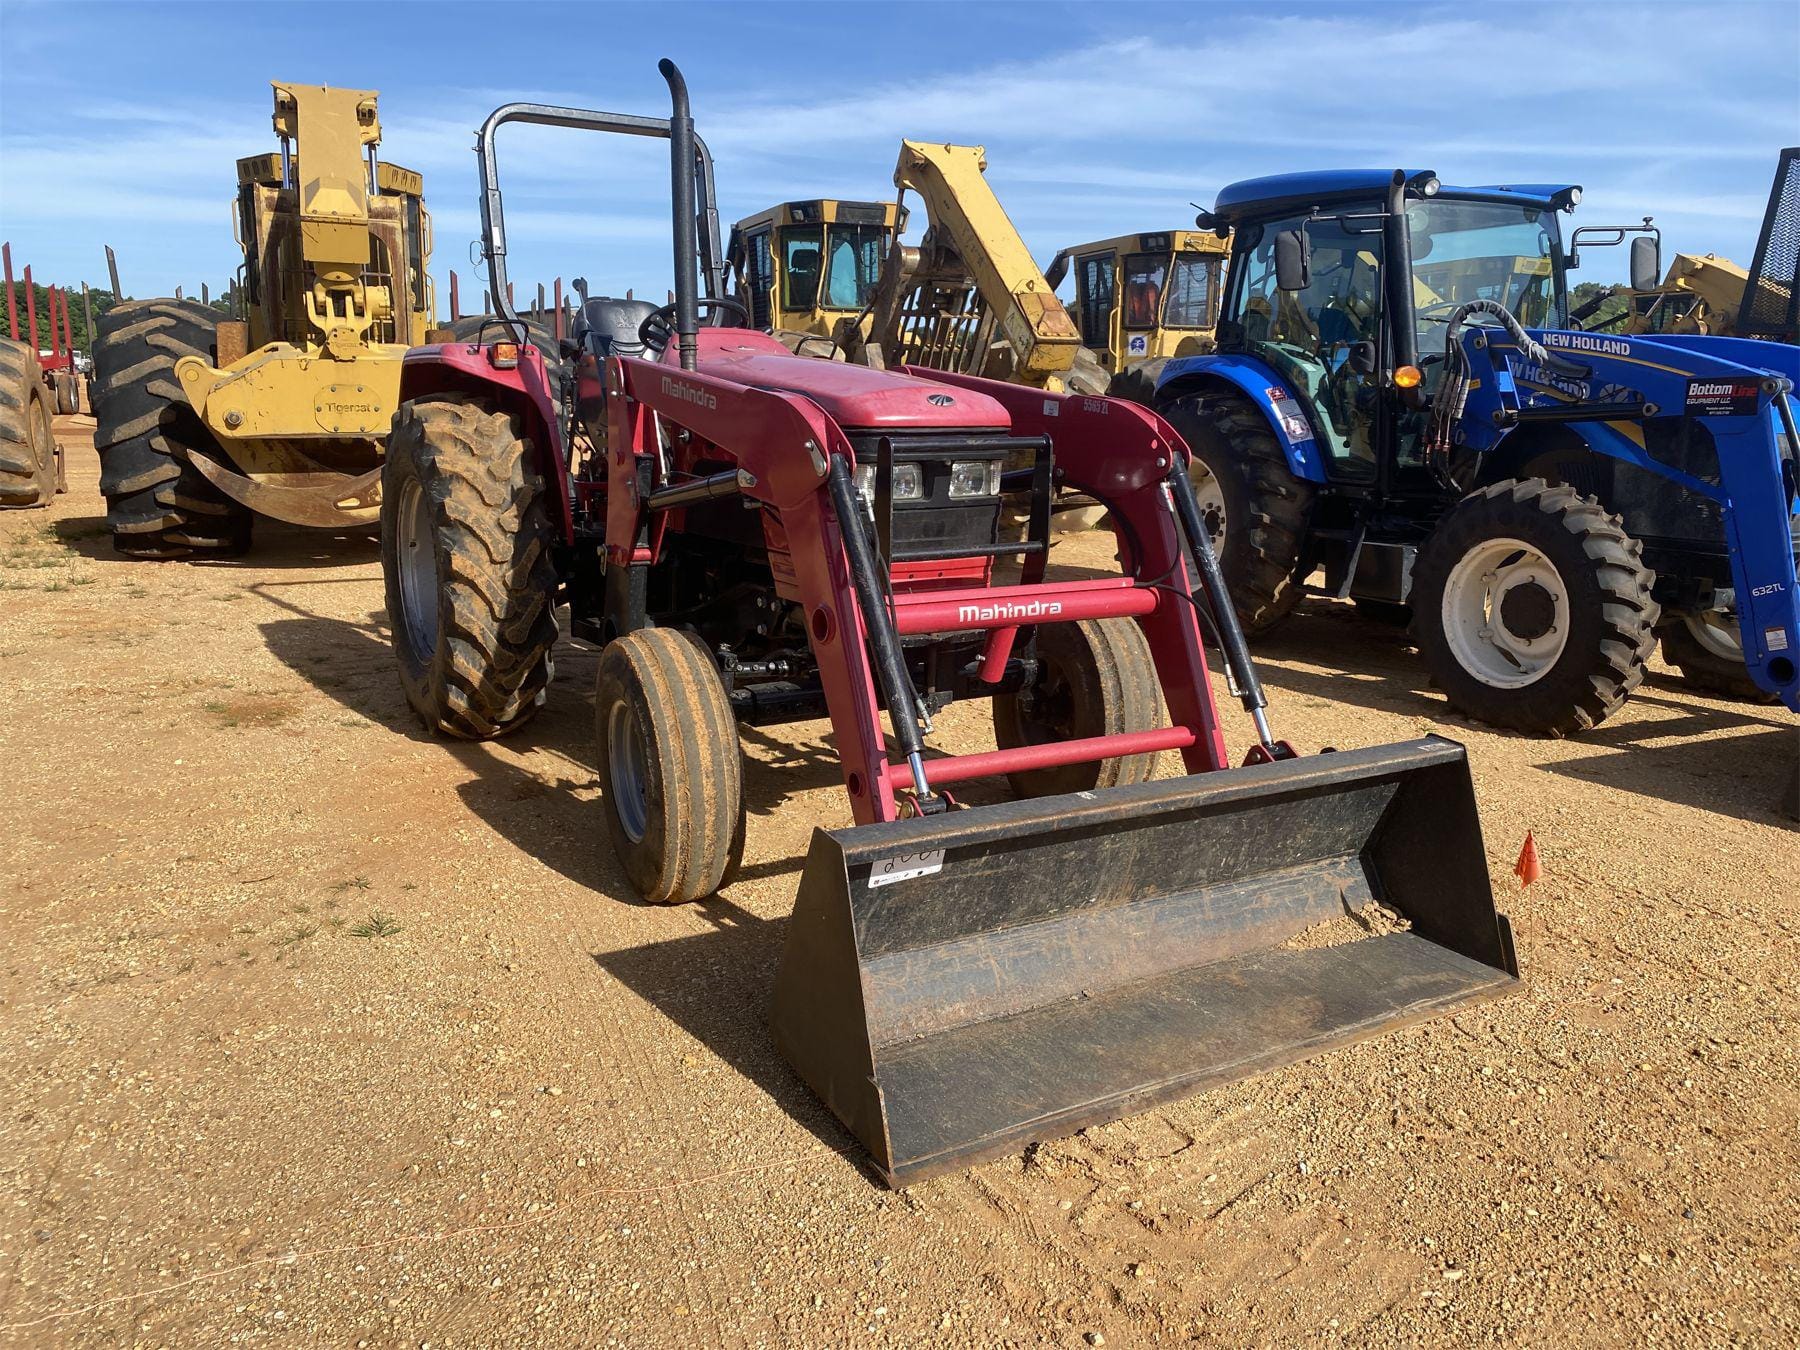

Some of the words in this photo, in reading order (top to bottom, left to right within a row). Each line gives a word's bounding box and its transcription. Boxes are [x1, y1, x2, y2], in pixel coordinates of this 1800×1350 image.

[1542, 333, 1570, 346] NEW
[1572, 336, 1631, 356] HOLLAND
[661, 376, 717, 410] Mahindra
[1686, 397, 1719, 405] EQUIPMENT
[325, 402, 371, 415] Tigercat
[1752, 582, 1785, 597] 632TL
[958, 600, 1062, 623] Mahindra
